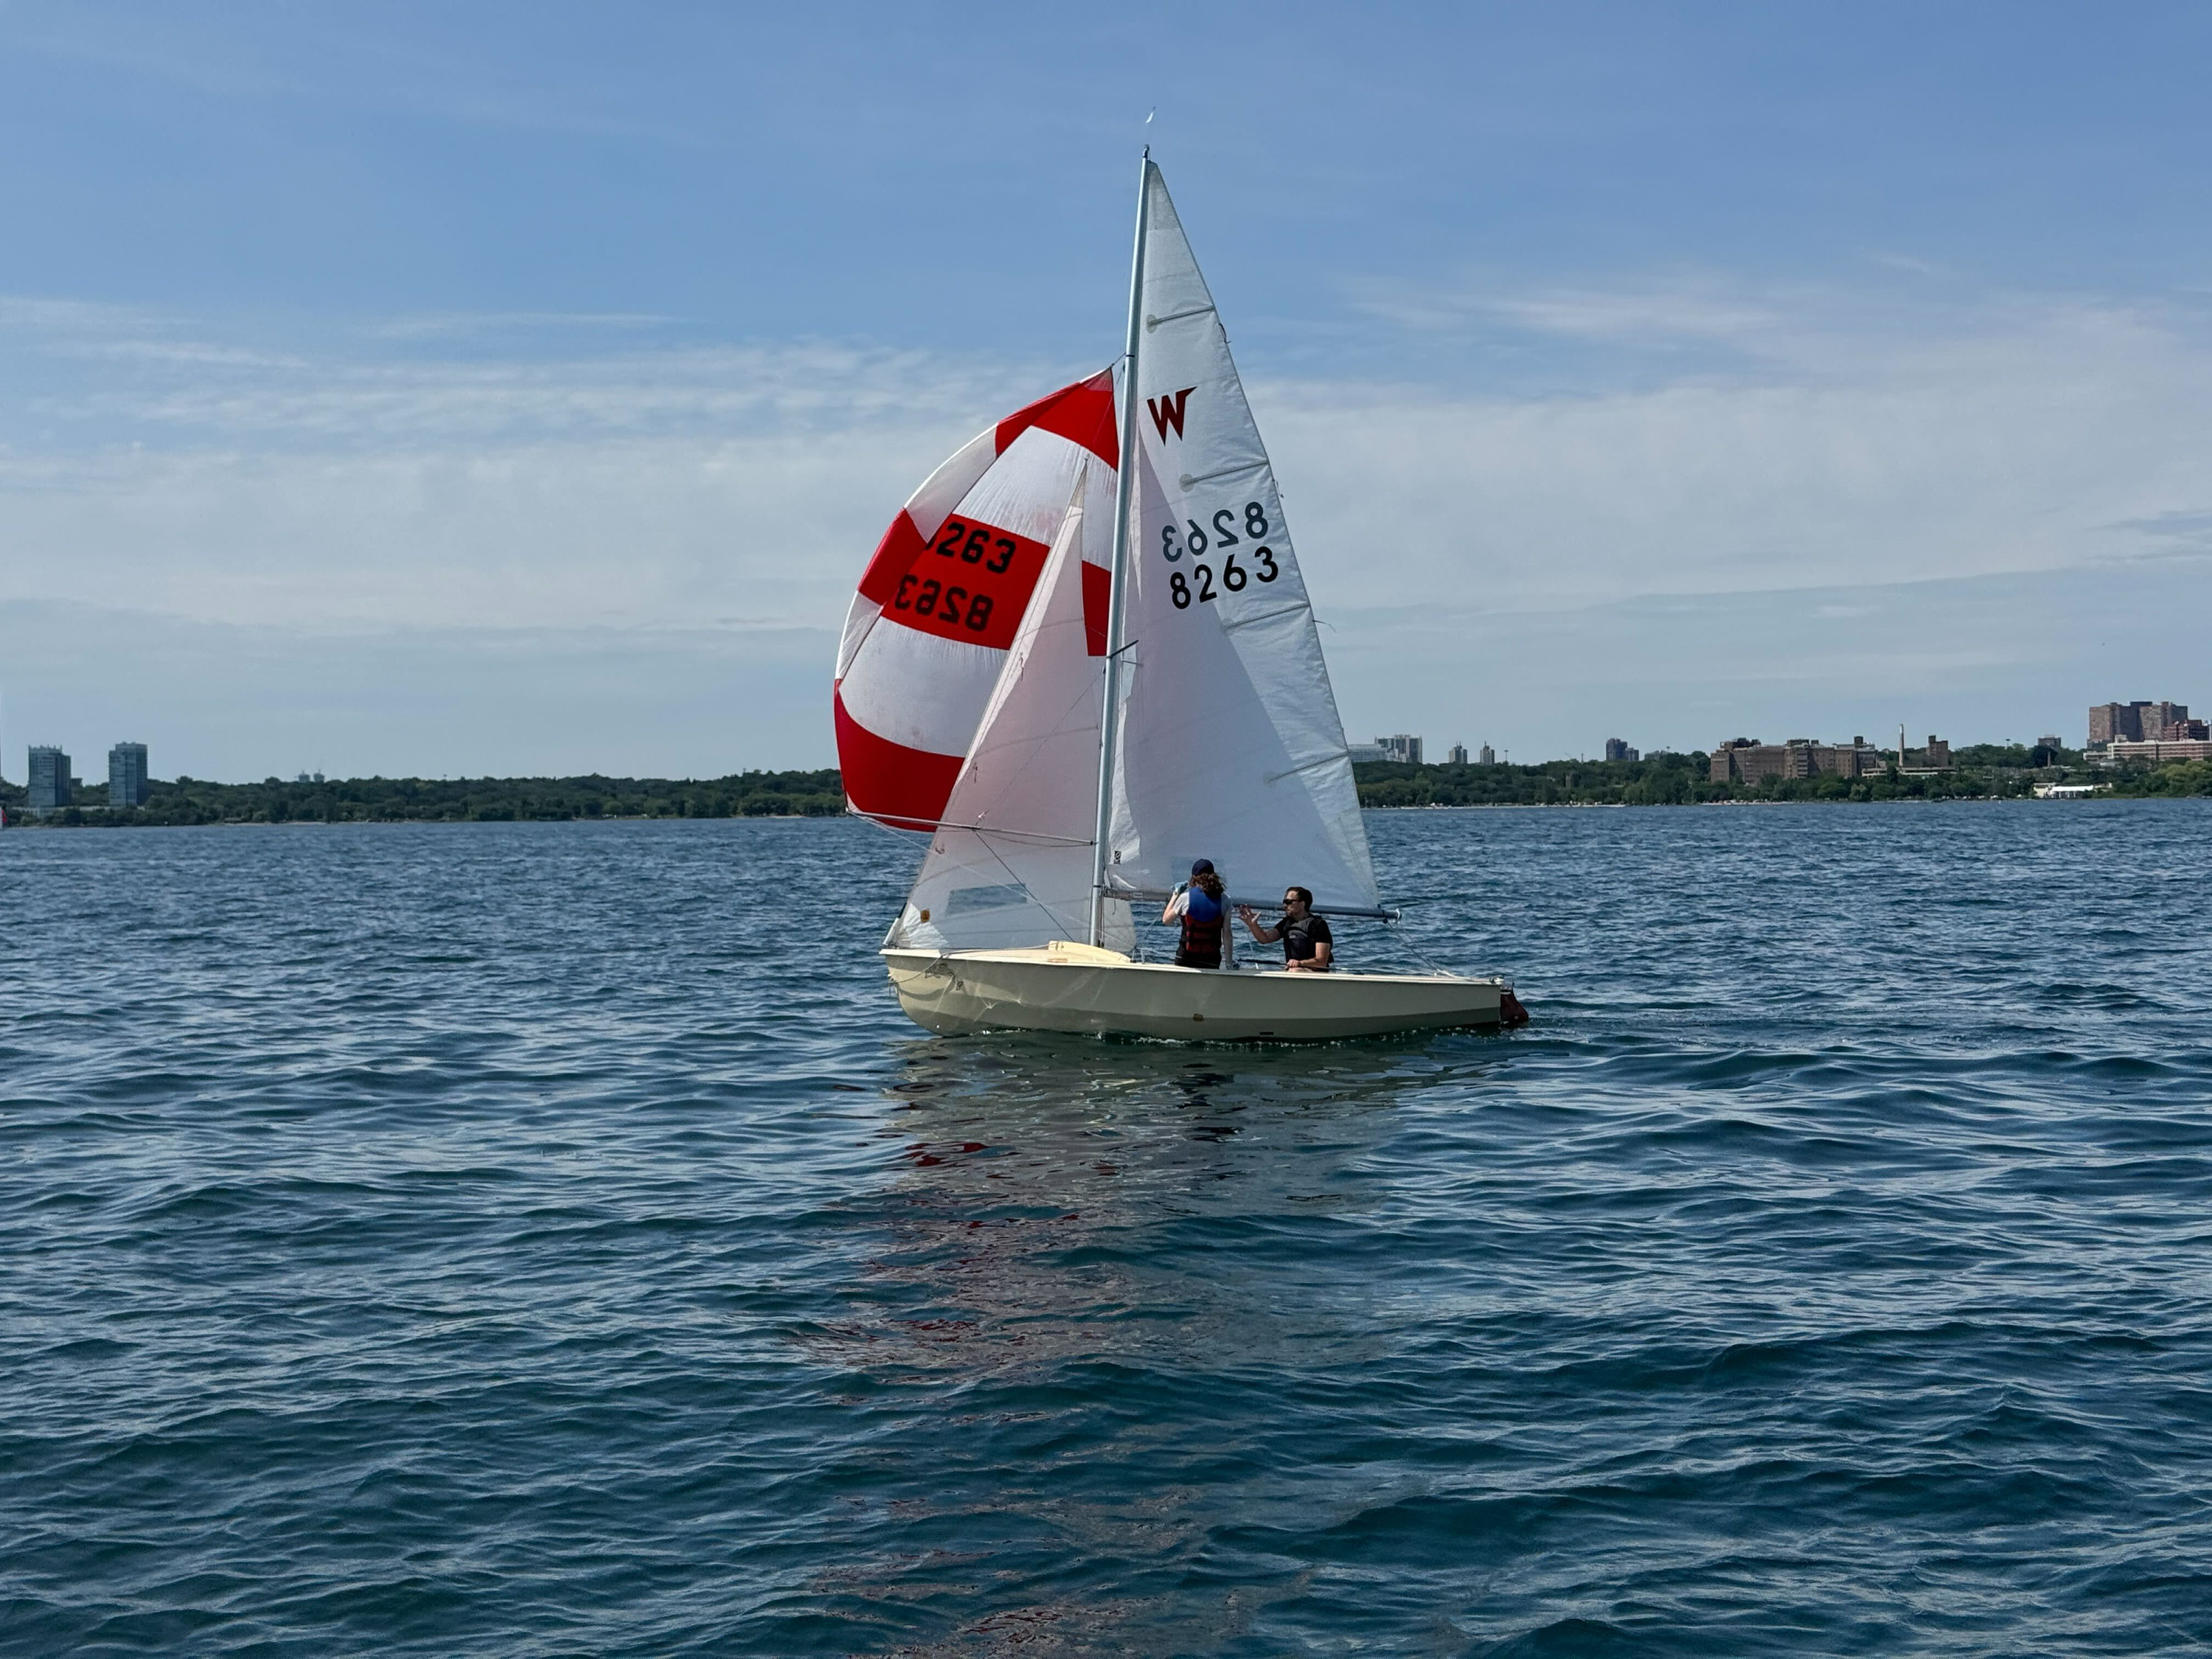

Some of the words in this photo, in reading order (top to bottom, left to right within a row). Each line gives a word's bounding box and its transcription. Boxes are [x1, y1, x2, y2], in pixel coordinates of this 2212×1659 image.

[1147, 386, 1197, 447] W
[925, 522, 1016, 574] 263
[1171, 546, 1279, 610] 8263
